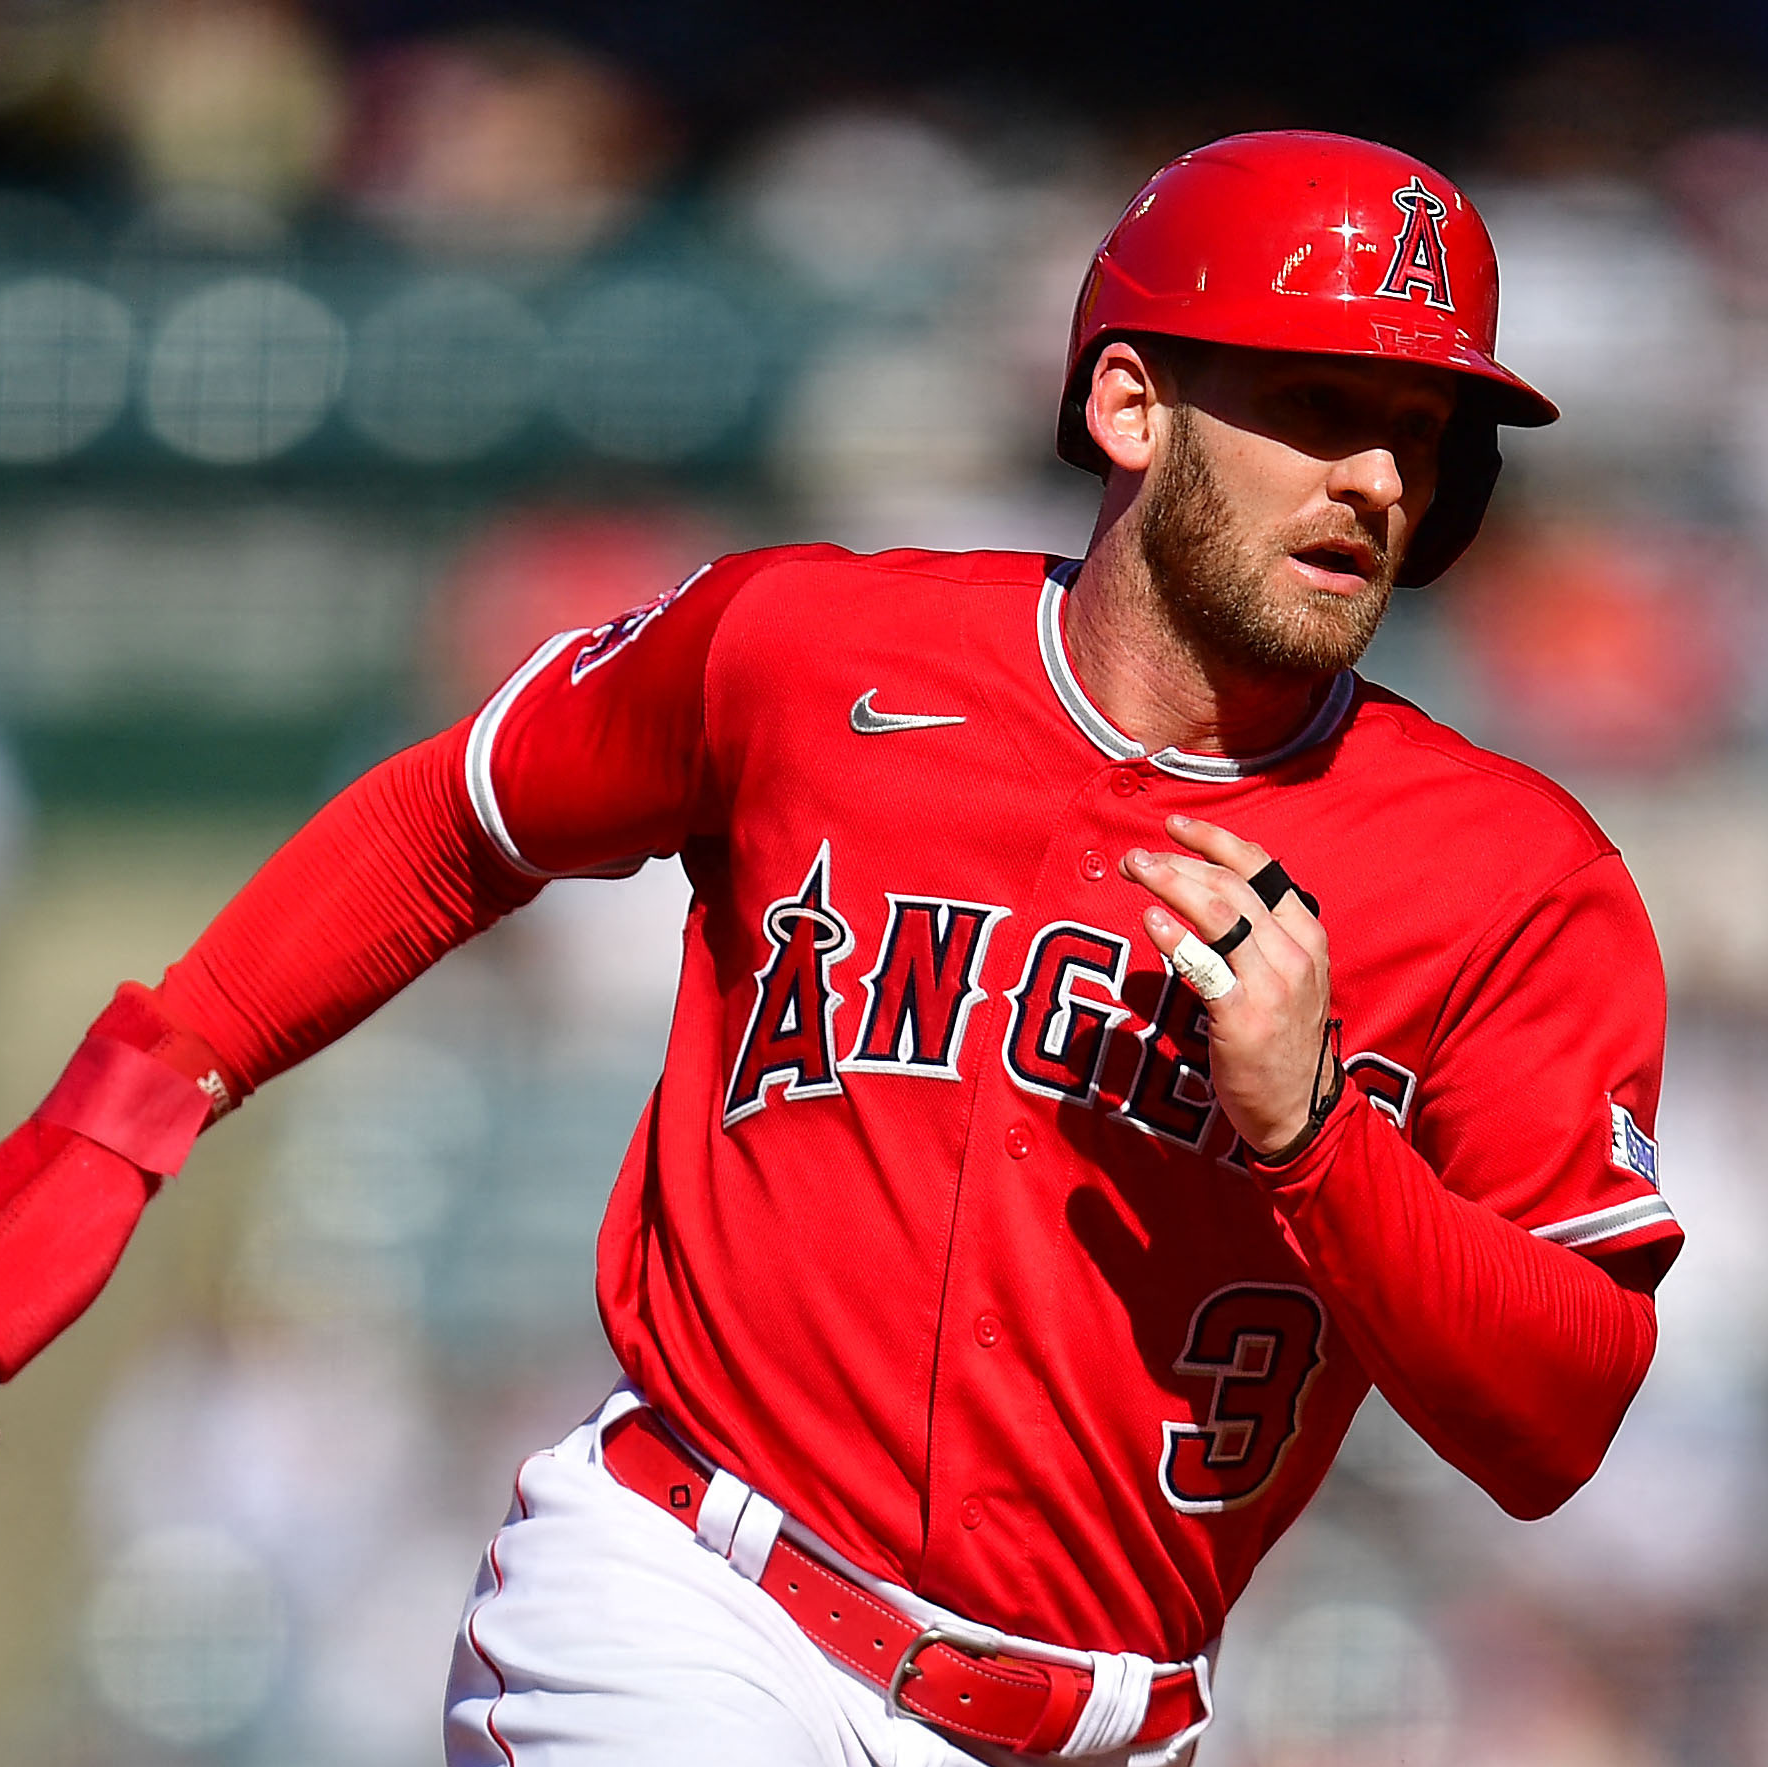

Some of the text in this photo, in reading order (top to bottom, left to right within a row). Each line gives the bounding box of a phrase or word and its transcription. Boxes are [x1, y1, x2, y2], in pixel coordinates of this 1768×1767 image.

[1374, 175, 1456, 313] A
[721, 837, 1419, 1180] ANGE
[1157, 1280, 1328, 1515] 3
